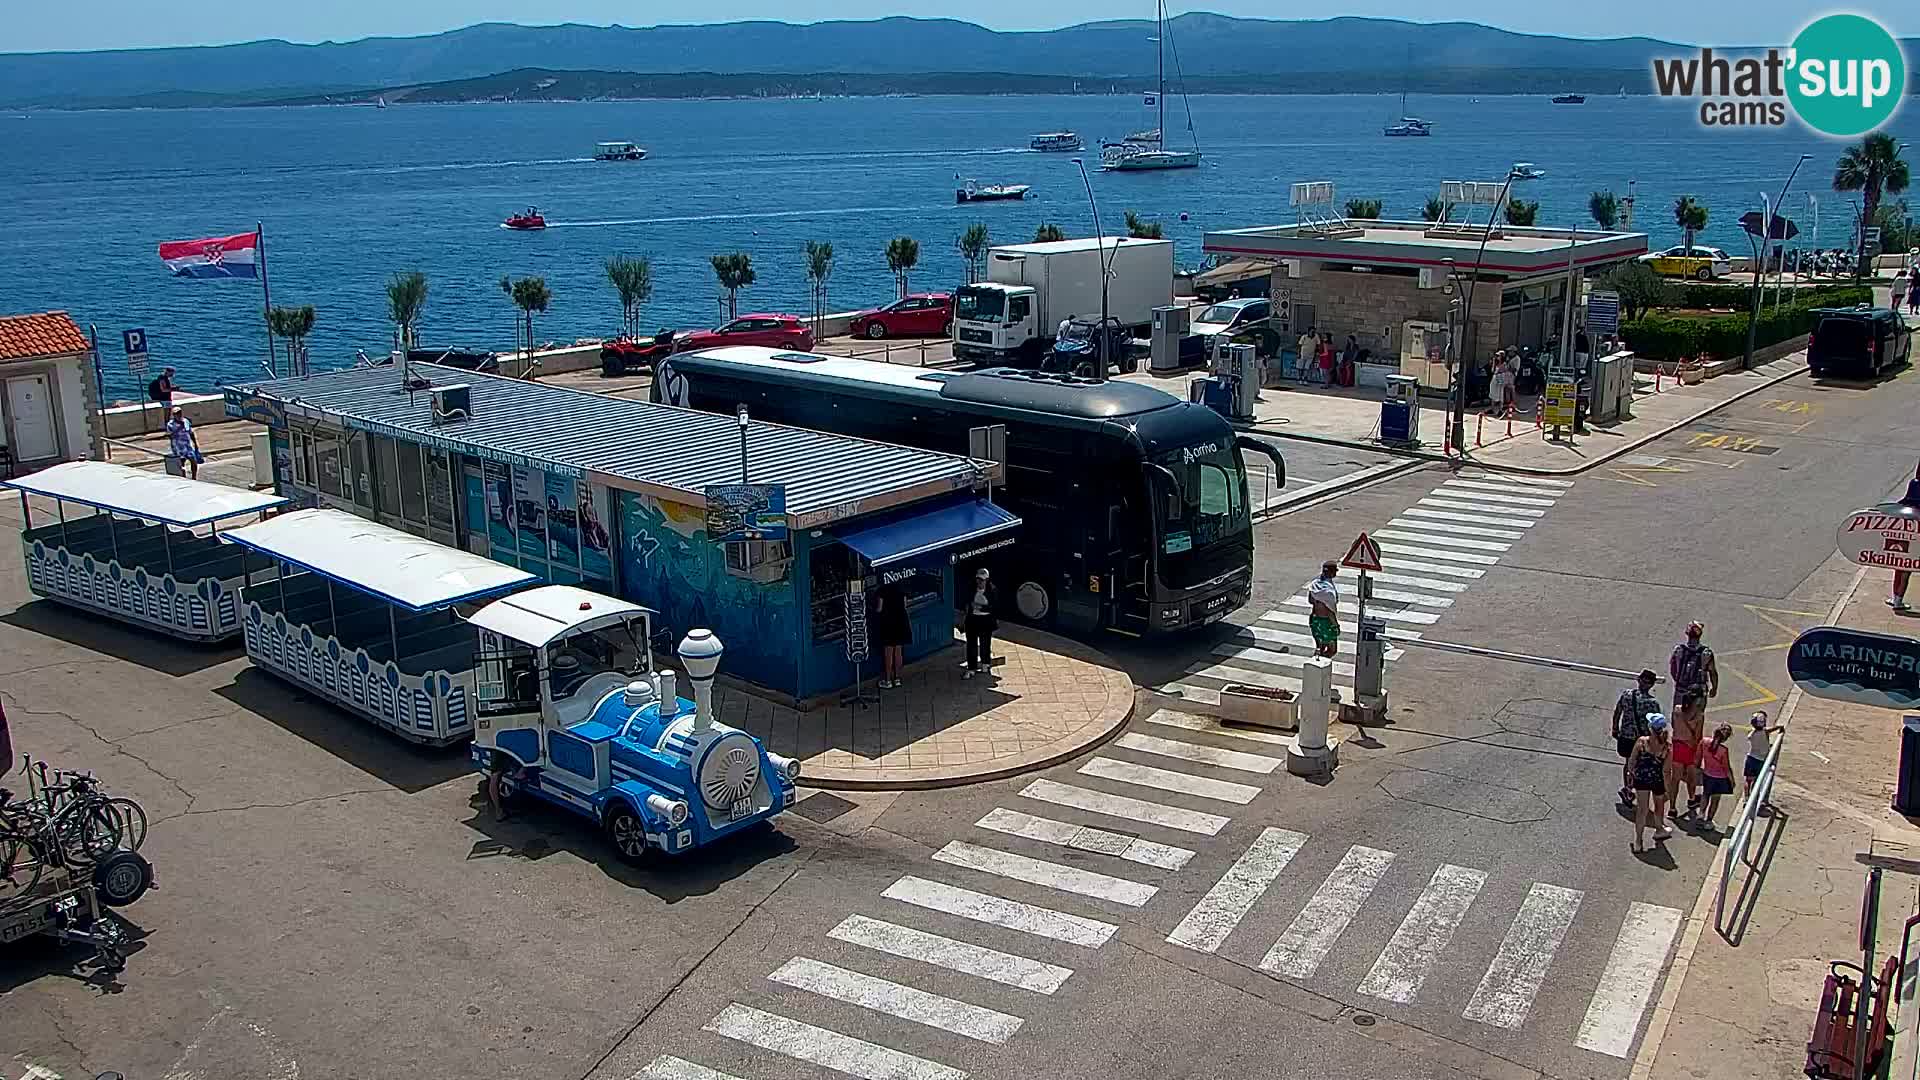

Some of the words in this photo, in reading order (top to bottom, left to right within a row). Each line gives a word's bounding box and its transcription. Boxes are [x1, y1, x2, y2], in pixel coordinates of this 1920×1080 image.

[128, 332, 140, 350] P
[436, 438, 467, 453] POSTAJA
[477, 448, 491, 458] BUS
[493, 452, 525, 465] STATION
[528, 458, 552, 472] TICKET
[554, 464, 582, 478] OFFICE
[1880, 530, 1917, 541] GRILL
[883, 567, 917, 585] iNovine
[1828, 662, 1865, 675] caffe
[1870, 666, 1896, 680] bar
